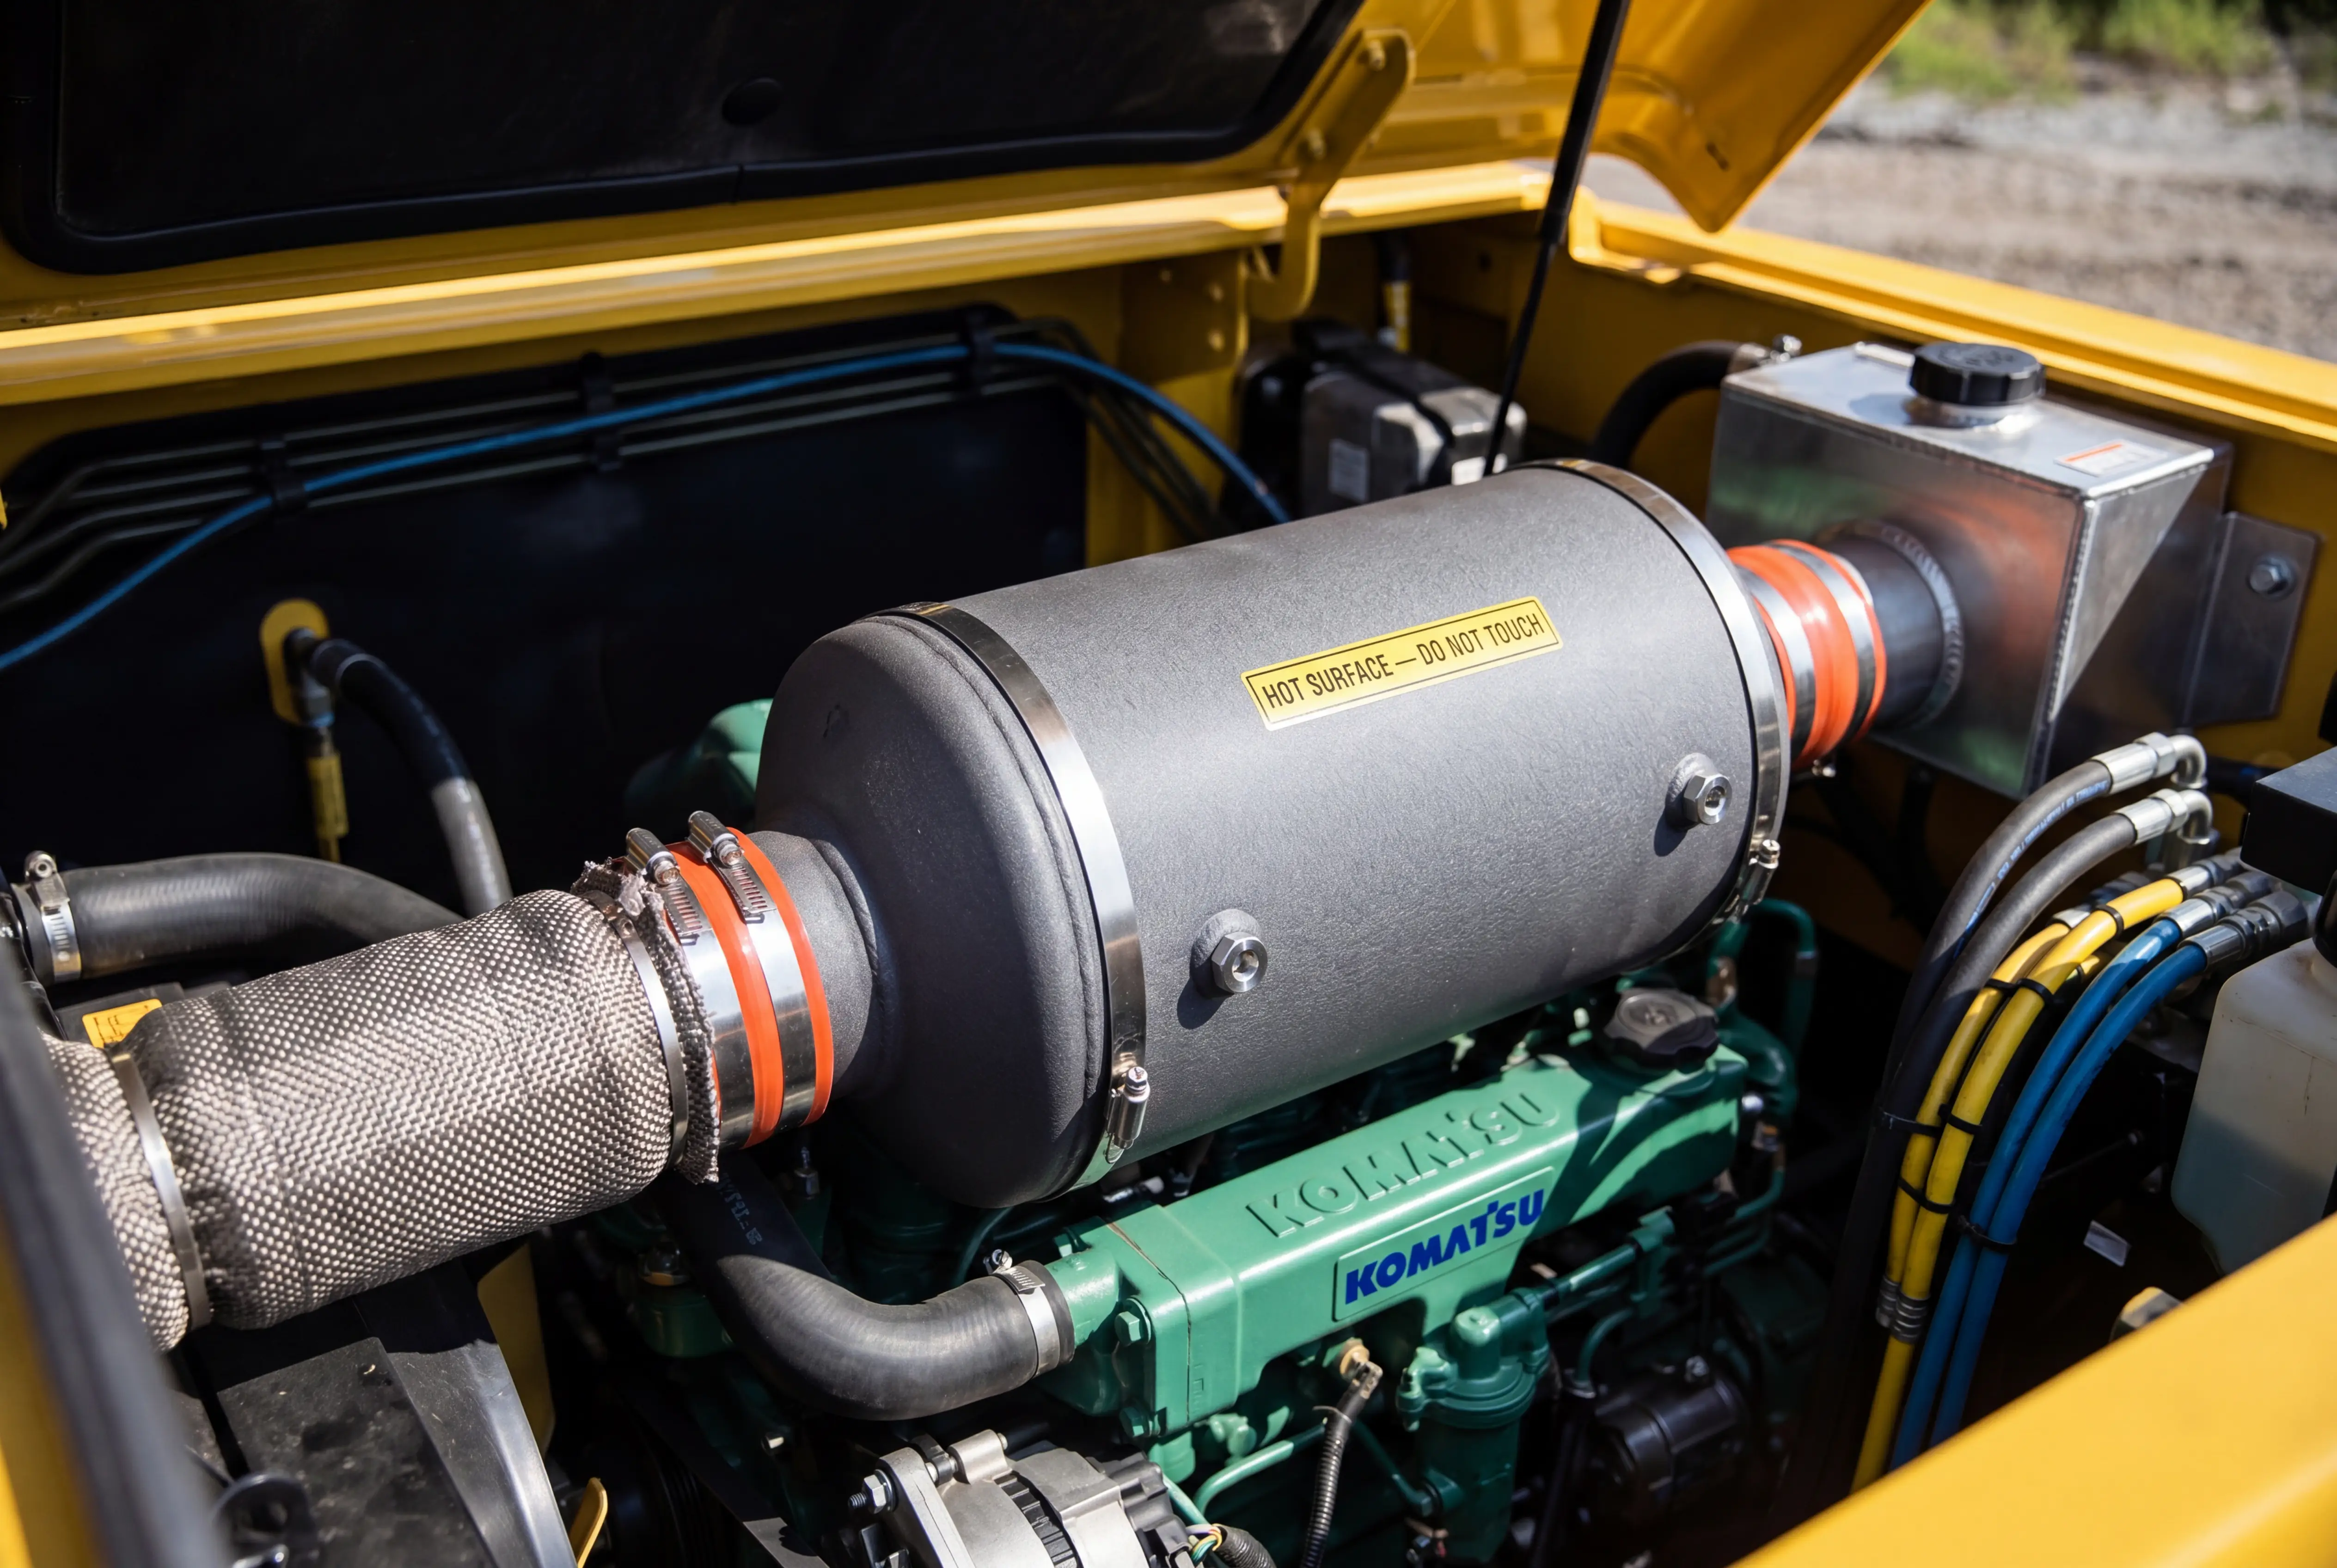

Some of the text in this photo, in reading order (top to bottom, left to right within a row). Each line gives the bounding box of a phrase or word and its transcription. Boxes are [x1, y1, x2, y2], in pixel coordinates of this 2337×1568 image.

[1262, 677, 1304, 708] HOT
[1305, 654, 1394, 696] SURFACE
[1416, 640, 1446, 665] DO
[1445, 629, 1484, 657] NOT
[1483, 613, 1545, 646] TOUCH
[1245, 1093, 1560, 1238] KOMATSU
[1345, 1188, 1544, 1305] KOMATSU
